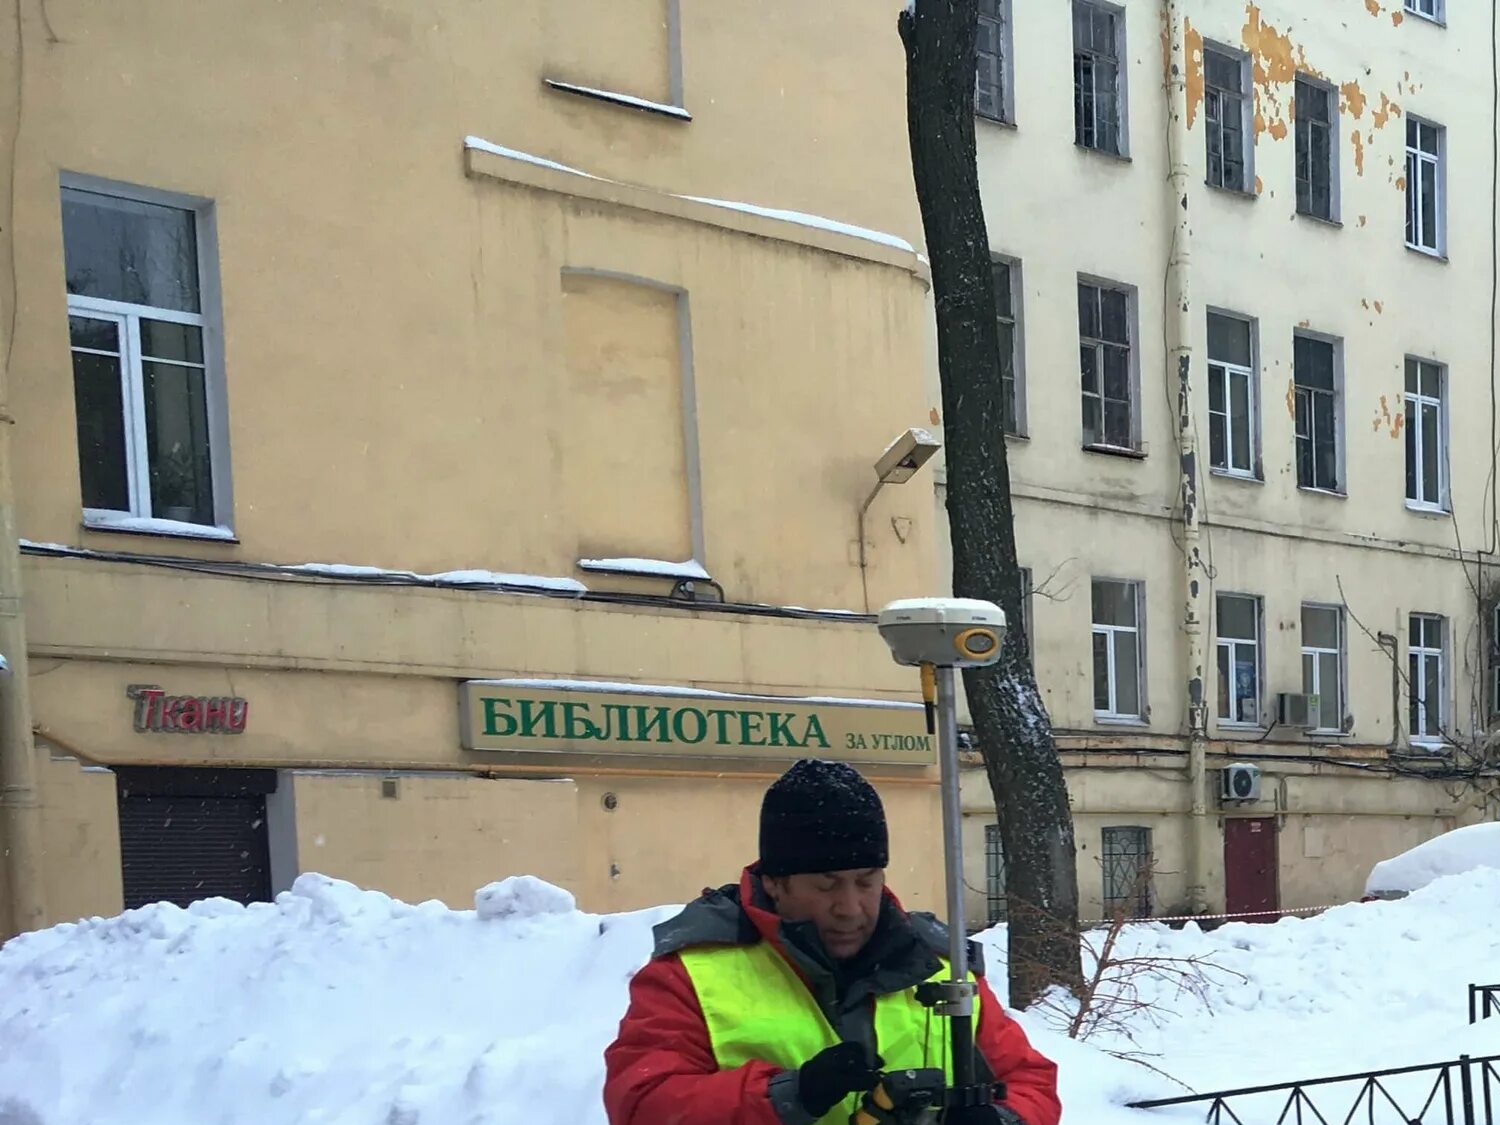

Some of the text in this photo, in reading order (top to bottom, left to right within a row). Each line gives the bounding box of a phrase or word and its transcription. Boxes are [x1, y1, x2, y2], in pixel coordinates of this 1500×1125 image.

[129, 685, 249, 732] Ткани
[479, 697, 831, 748] БИБЛИОТЕКА
[845, 732, 932, 752] ЗА УГЛОМ
